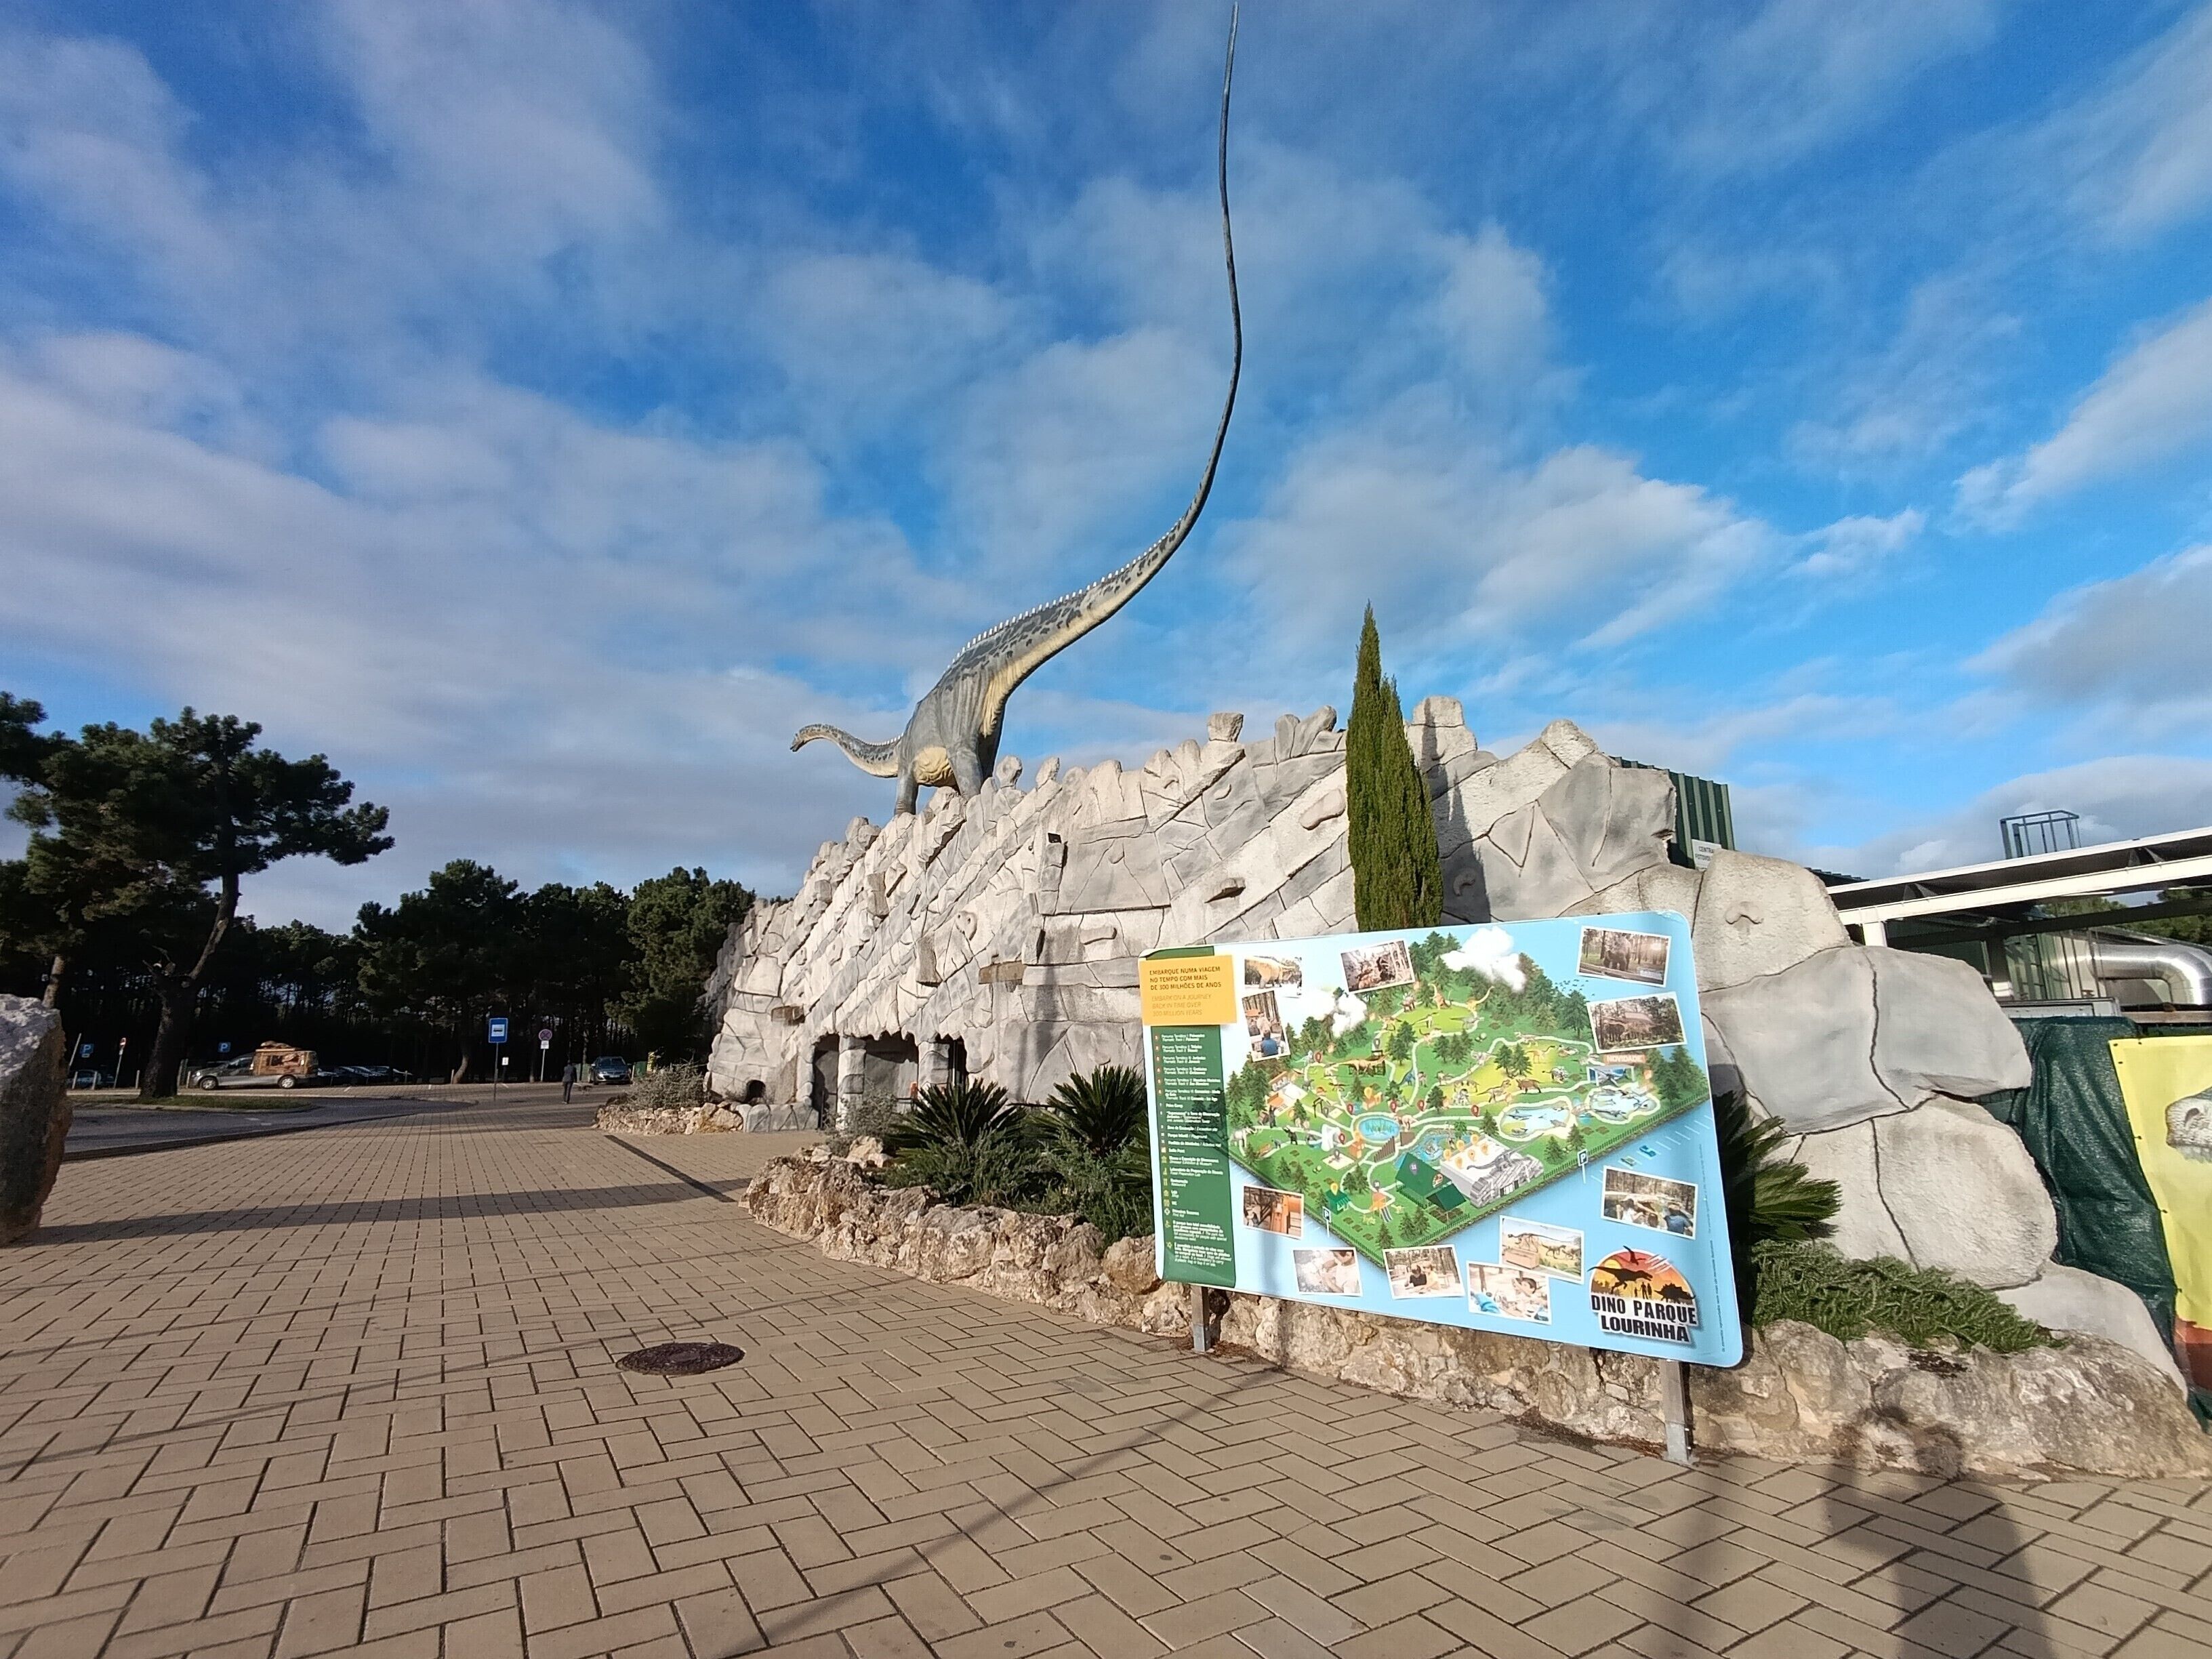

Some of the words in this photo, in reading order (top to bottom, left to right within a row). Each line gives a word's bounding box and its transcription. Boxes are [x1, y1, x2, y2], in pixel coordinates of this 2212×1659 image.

[1591, 1294, 1626, 1314] DINO
[1633, 1300, 1697, 1325] PARQUE
[1601, 1315, 1689, 1342] LOURINHÃ
